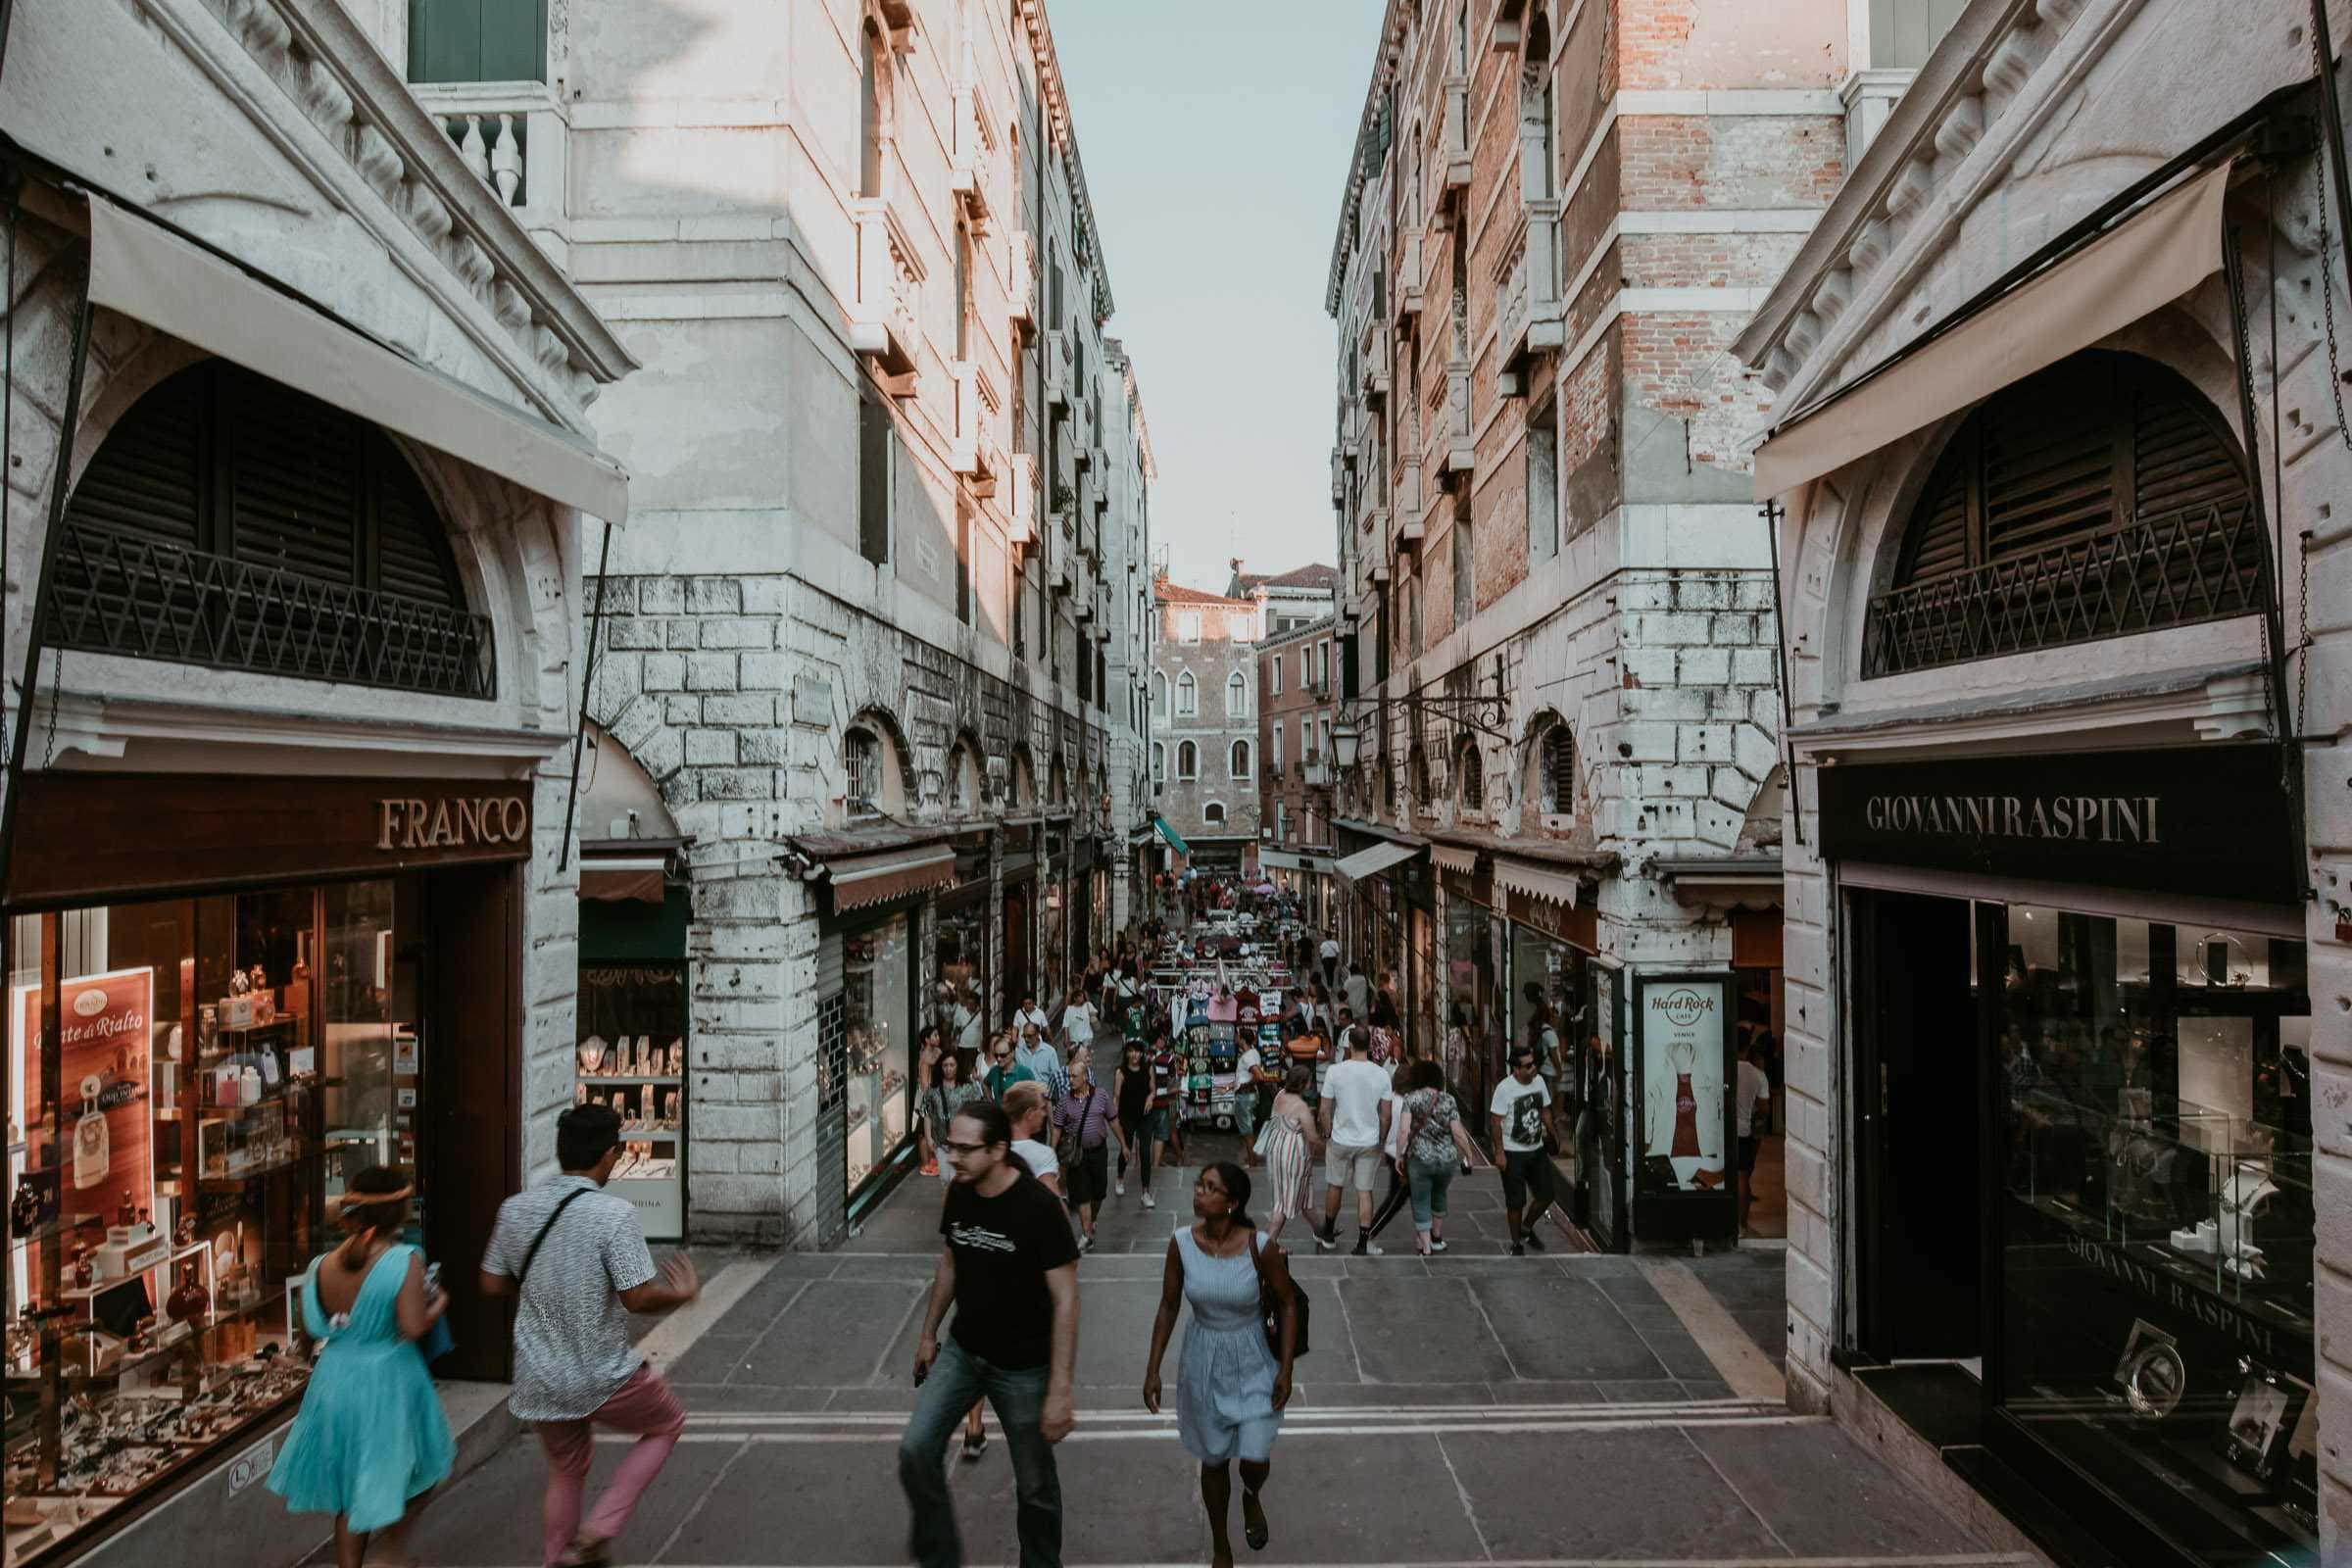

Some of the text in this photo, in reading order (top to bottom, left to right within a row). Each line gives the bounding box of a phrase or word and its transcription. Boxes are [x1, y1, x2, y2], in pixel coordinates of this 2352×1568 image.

[376, 797, 527, 850] FRANCO
[1866, 796, 2161, 843] GIOVANNI RASPINI
[83, 1023, 95, 1039] di
[96, 1009, 143, 1037] Rialto
[1651, 996, 1714, 1011] Hard Rock
[2068, 1234, 2274, 1355] GIOVANNI RASPINI
